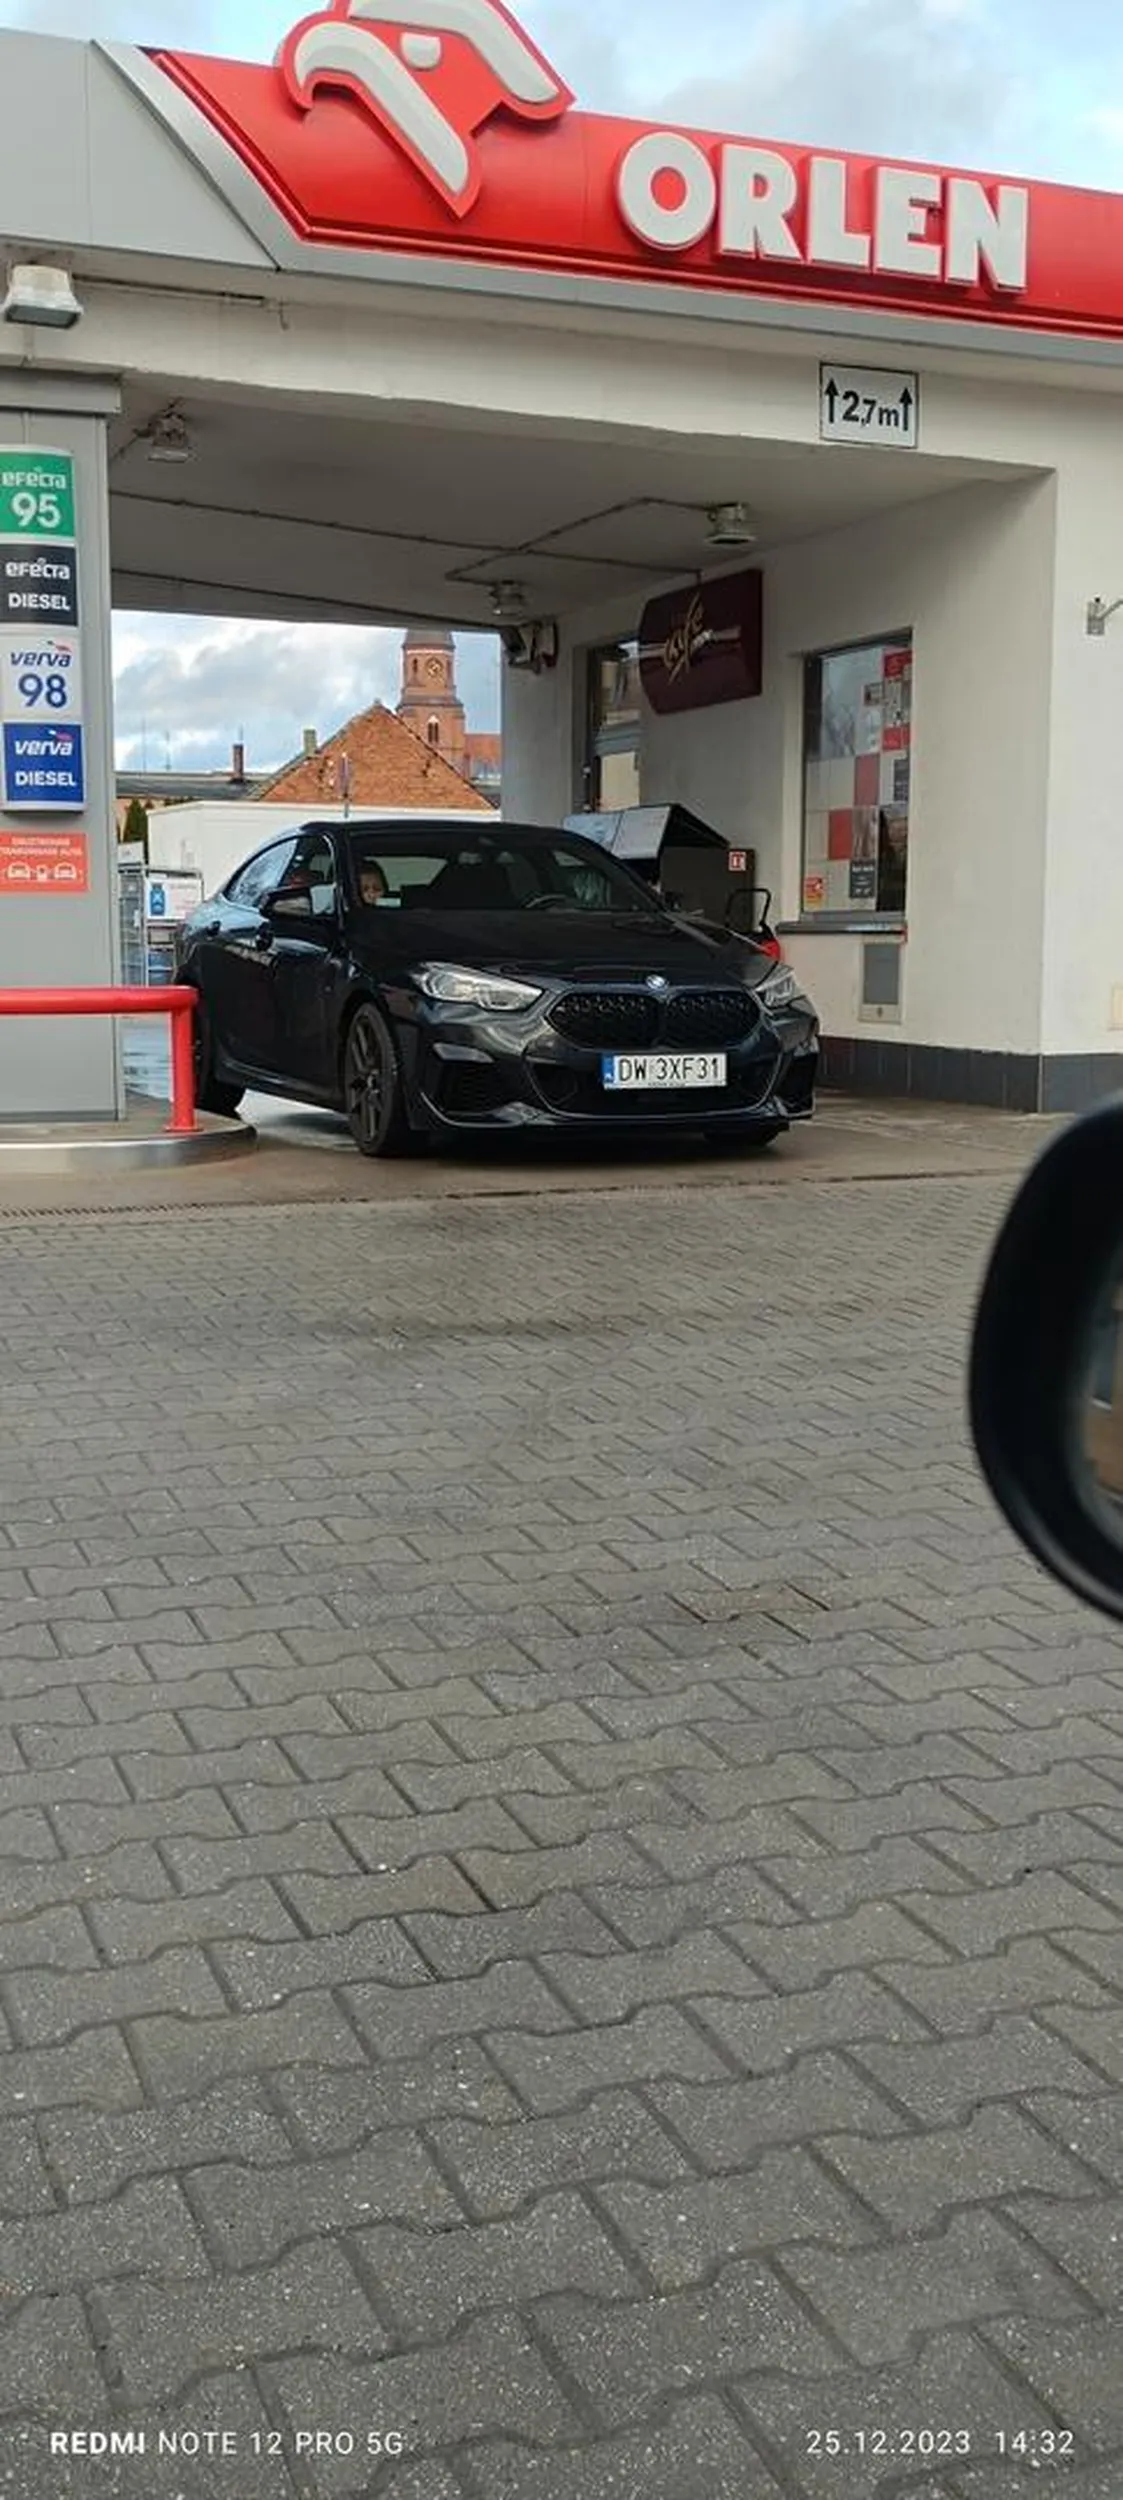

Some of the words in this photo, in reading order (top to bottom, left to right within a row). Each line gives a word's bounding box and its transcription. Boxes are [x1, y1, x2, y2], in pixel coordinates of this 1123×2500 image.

[618, 131, 1029, 292] ORLEN
[11, 492, 61, 528] 95
[8, 592, 71, 611] DIESEL
[10, 651, 72, 668] verva
[18, 673, 67, 709] 98
[14, 740, 73, 756] verva
[15, 771, 77, 786] DIESEL
[619, 1058, 647, 1081] DW
[656, 1057, 718, 1080] 3XF31
